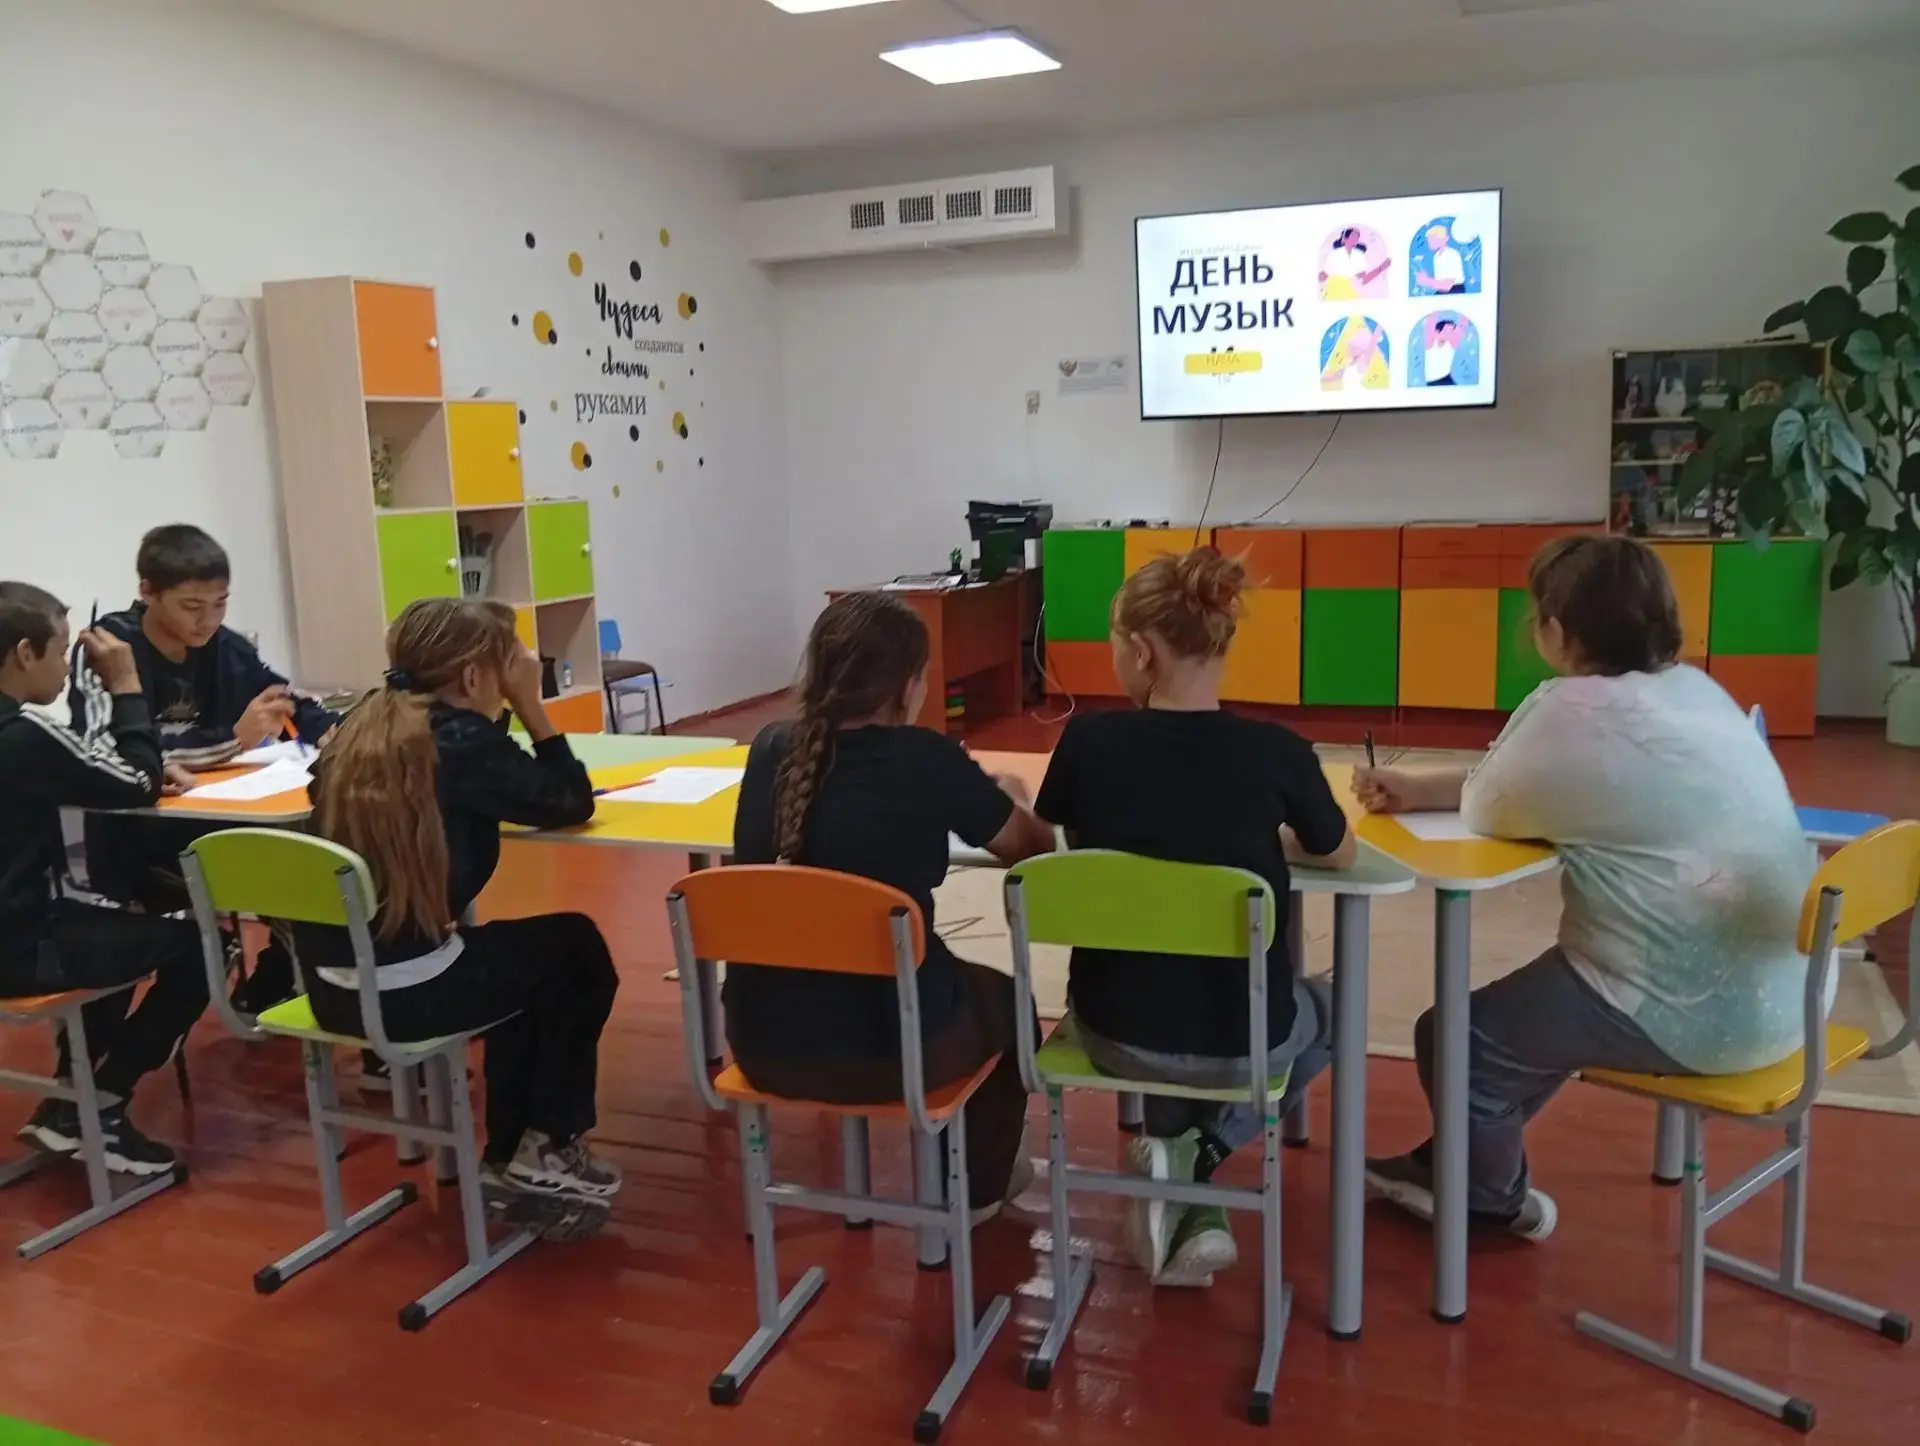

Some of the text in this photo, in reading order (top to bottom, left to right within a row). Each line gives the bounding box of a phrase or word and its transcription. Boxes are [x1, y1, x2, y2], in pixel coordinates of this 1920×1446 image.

[1170, 253, 1274, 297] ДЕНЬ
[594, 281, 663, 340] Чудеса
[1153, 297, 1295, 335] МУЗЫК
[574, 392, 647, 423] руками
